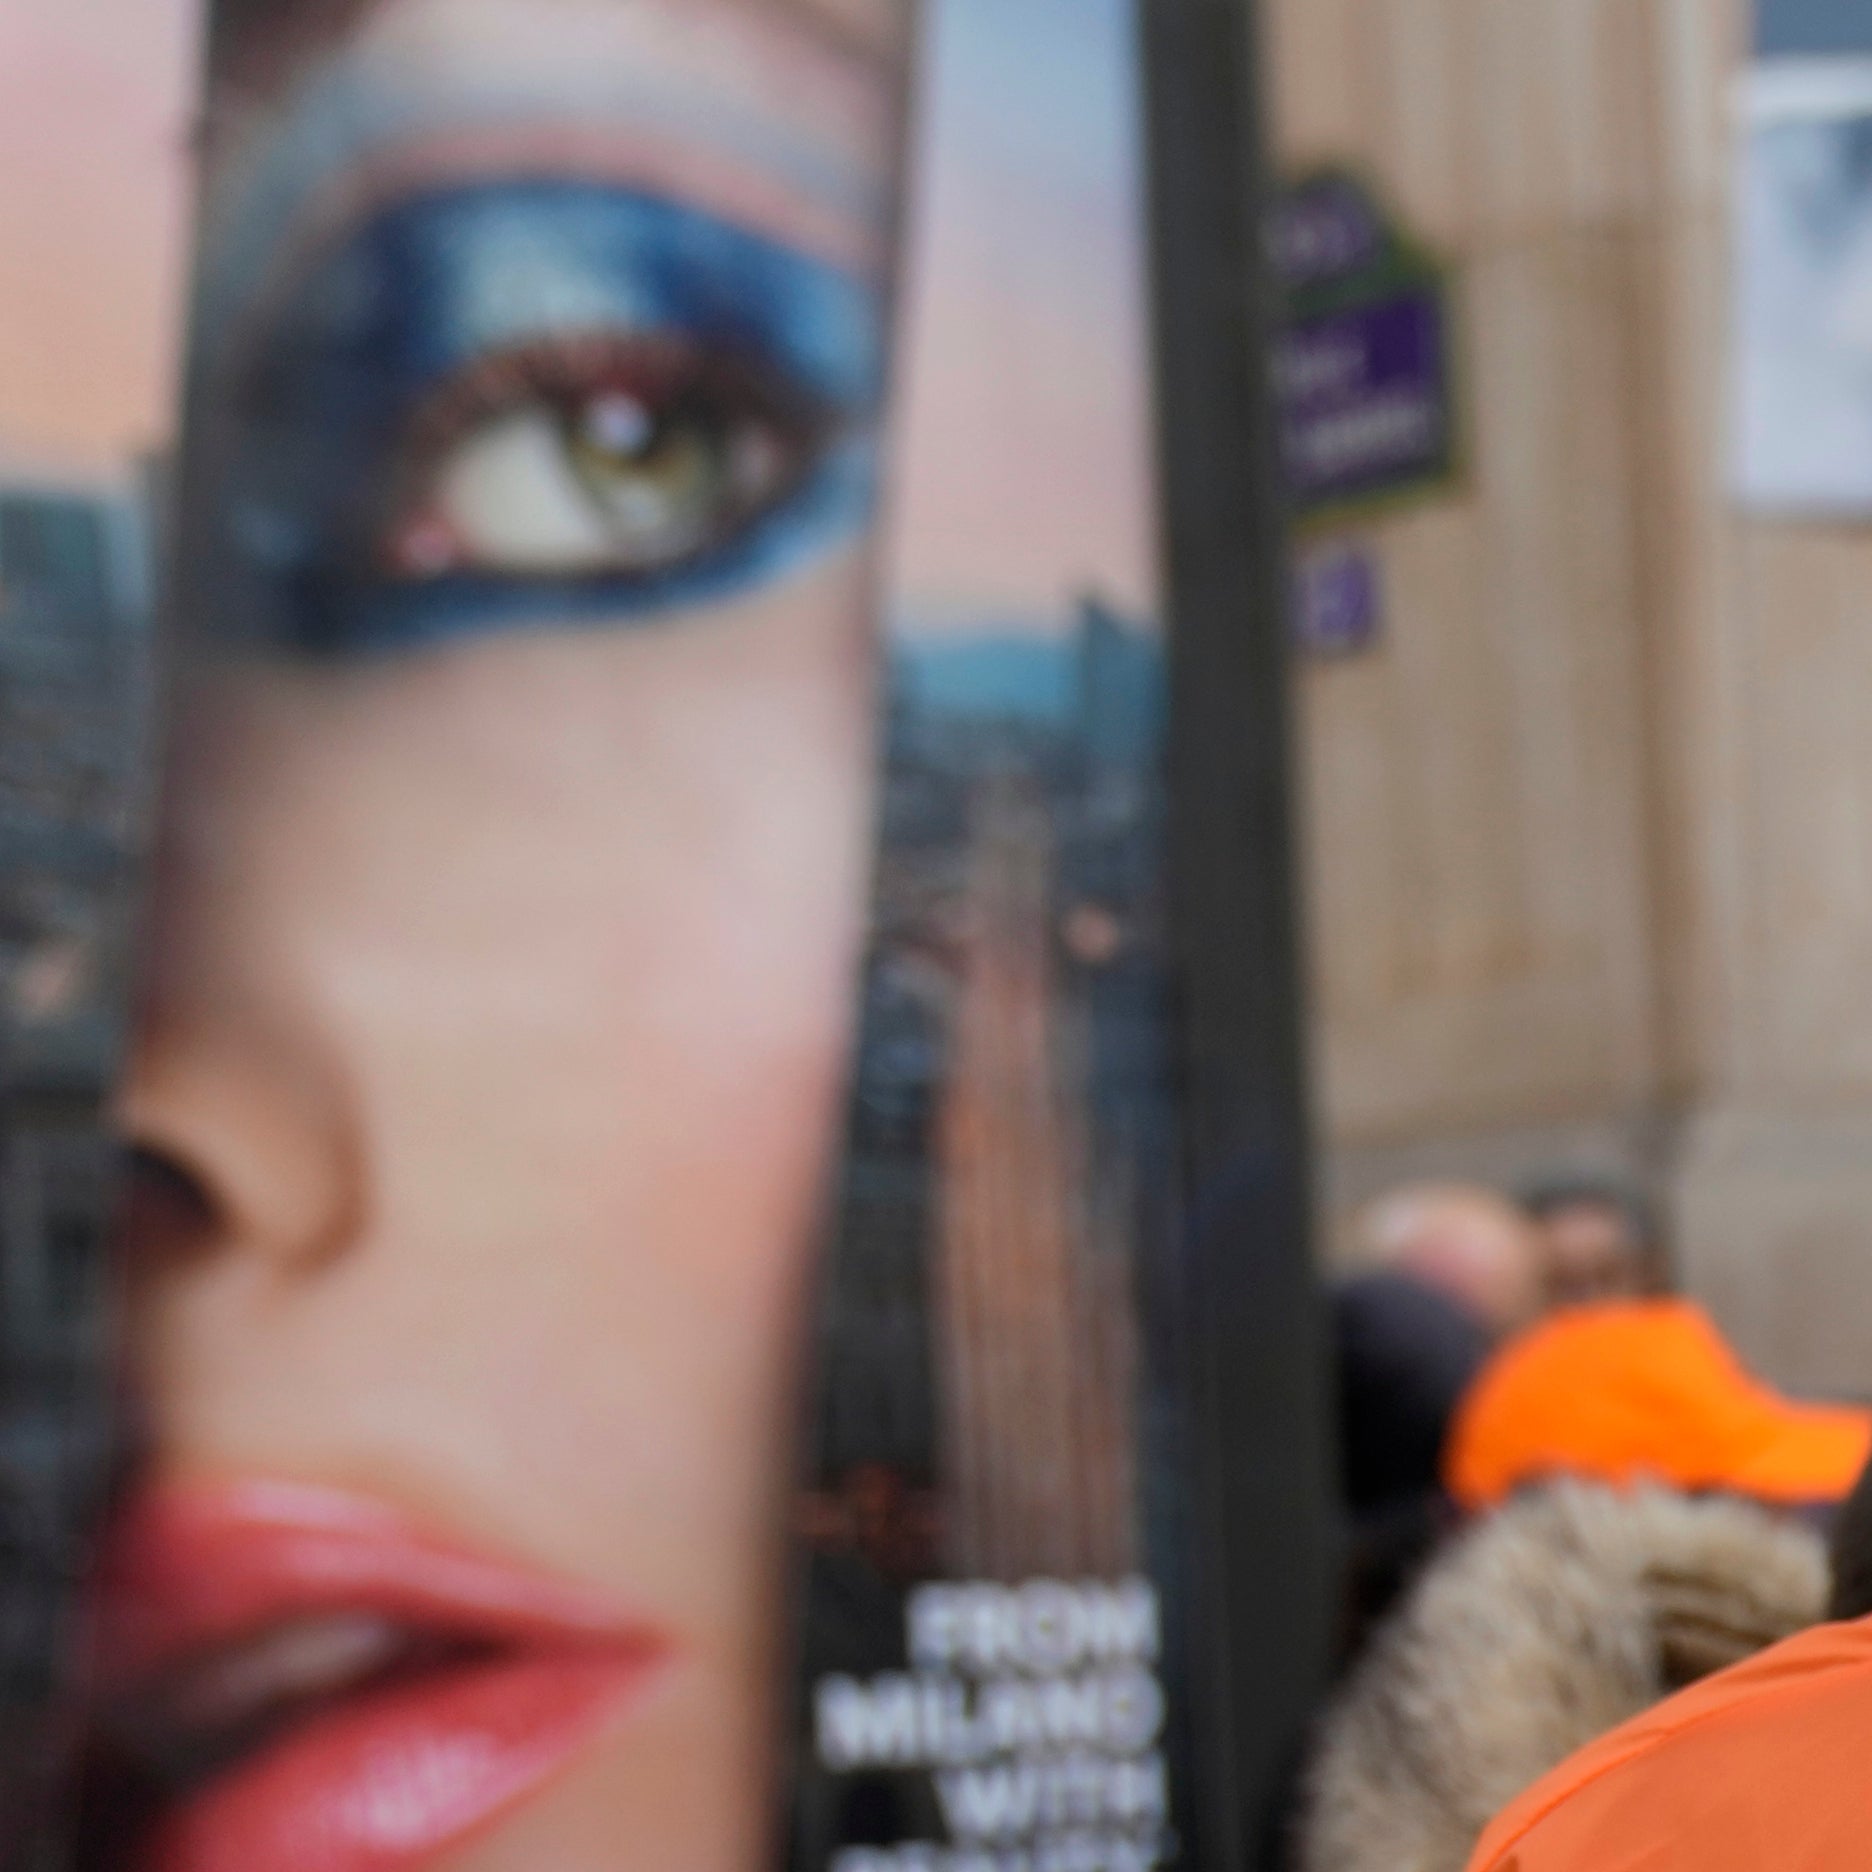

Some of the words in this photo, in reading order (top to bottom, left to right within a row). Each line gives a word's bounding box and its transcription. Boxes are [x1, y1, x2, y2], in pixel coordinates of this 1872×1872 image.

[906, 1574, 1162, 1674] FROM
[812, 1662, 1166, 1774] MILANO
[932, 1750, 1170, 1840] WITH
